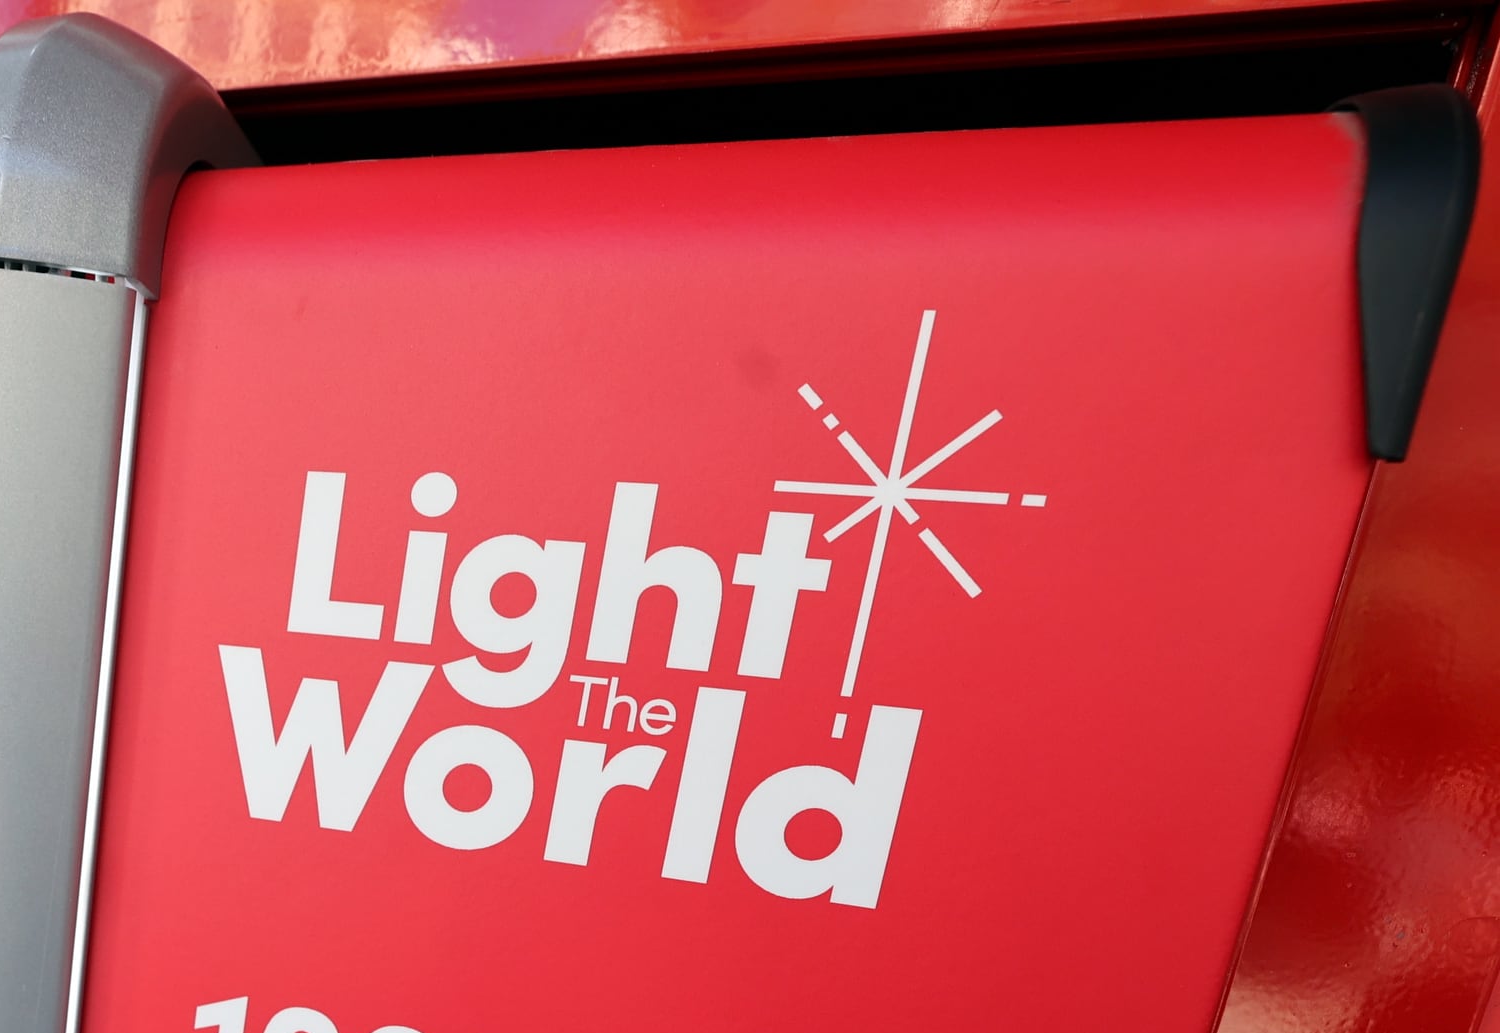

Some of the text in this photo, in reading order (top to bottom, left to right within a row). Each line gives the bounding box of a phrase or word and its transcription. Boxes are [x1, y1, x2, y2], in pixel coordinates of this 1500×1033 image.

[287, 471, 832, 708] Light
[570, 675, 677, 736] The
[218, 644, 922, 909] World
